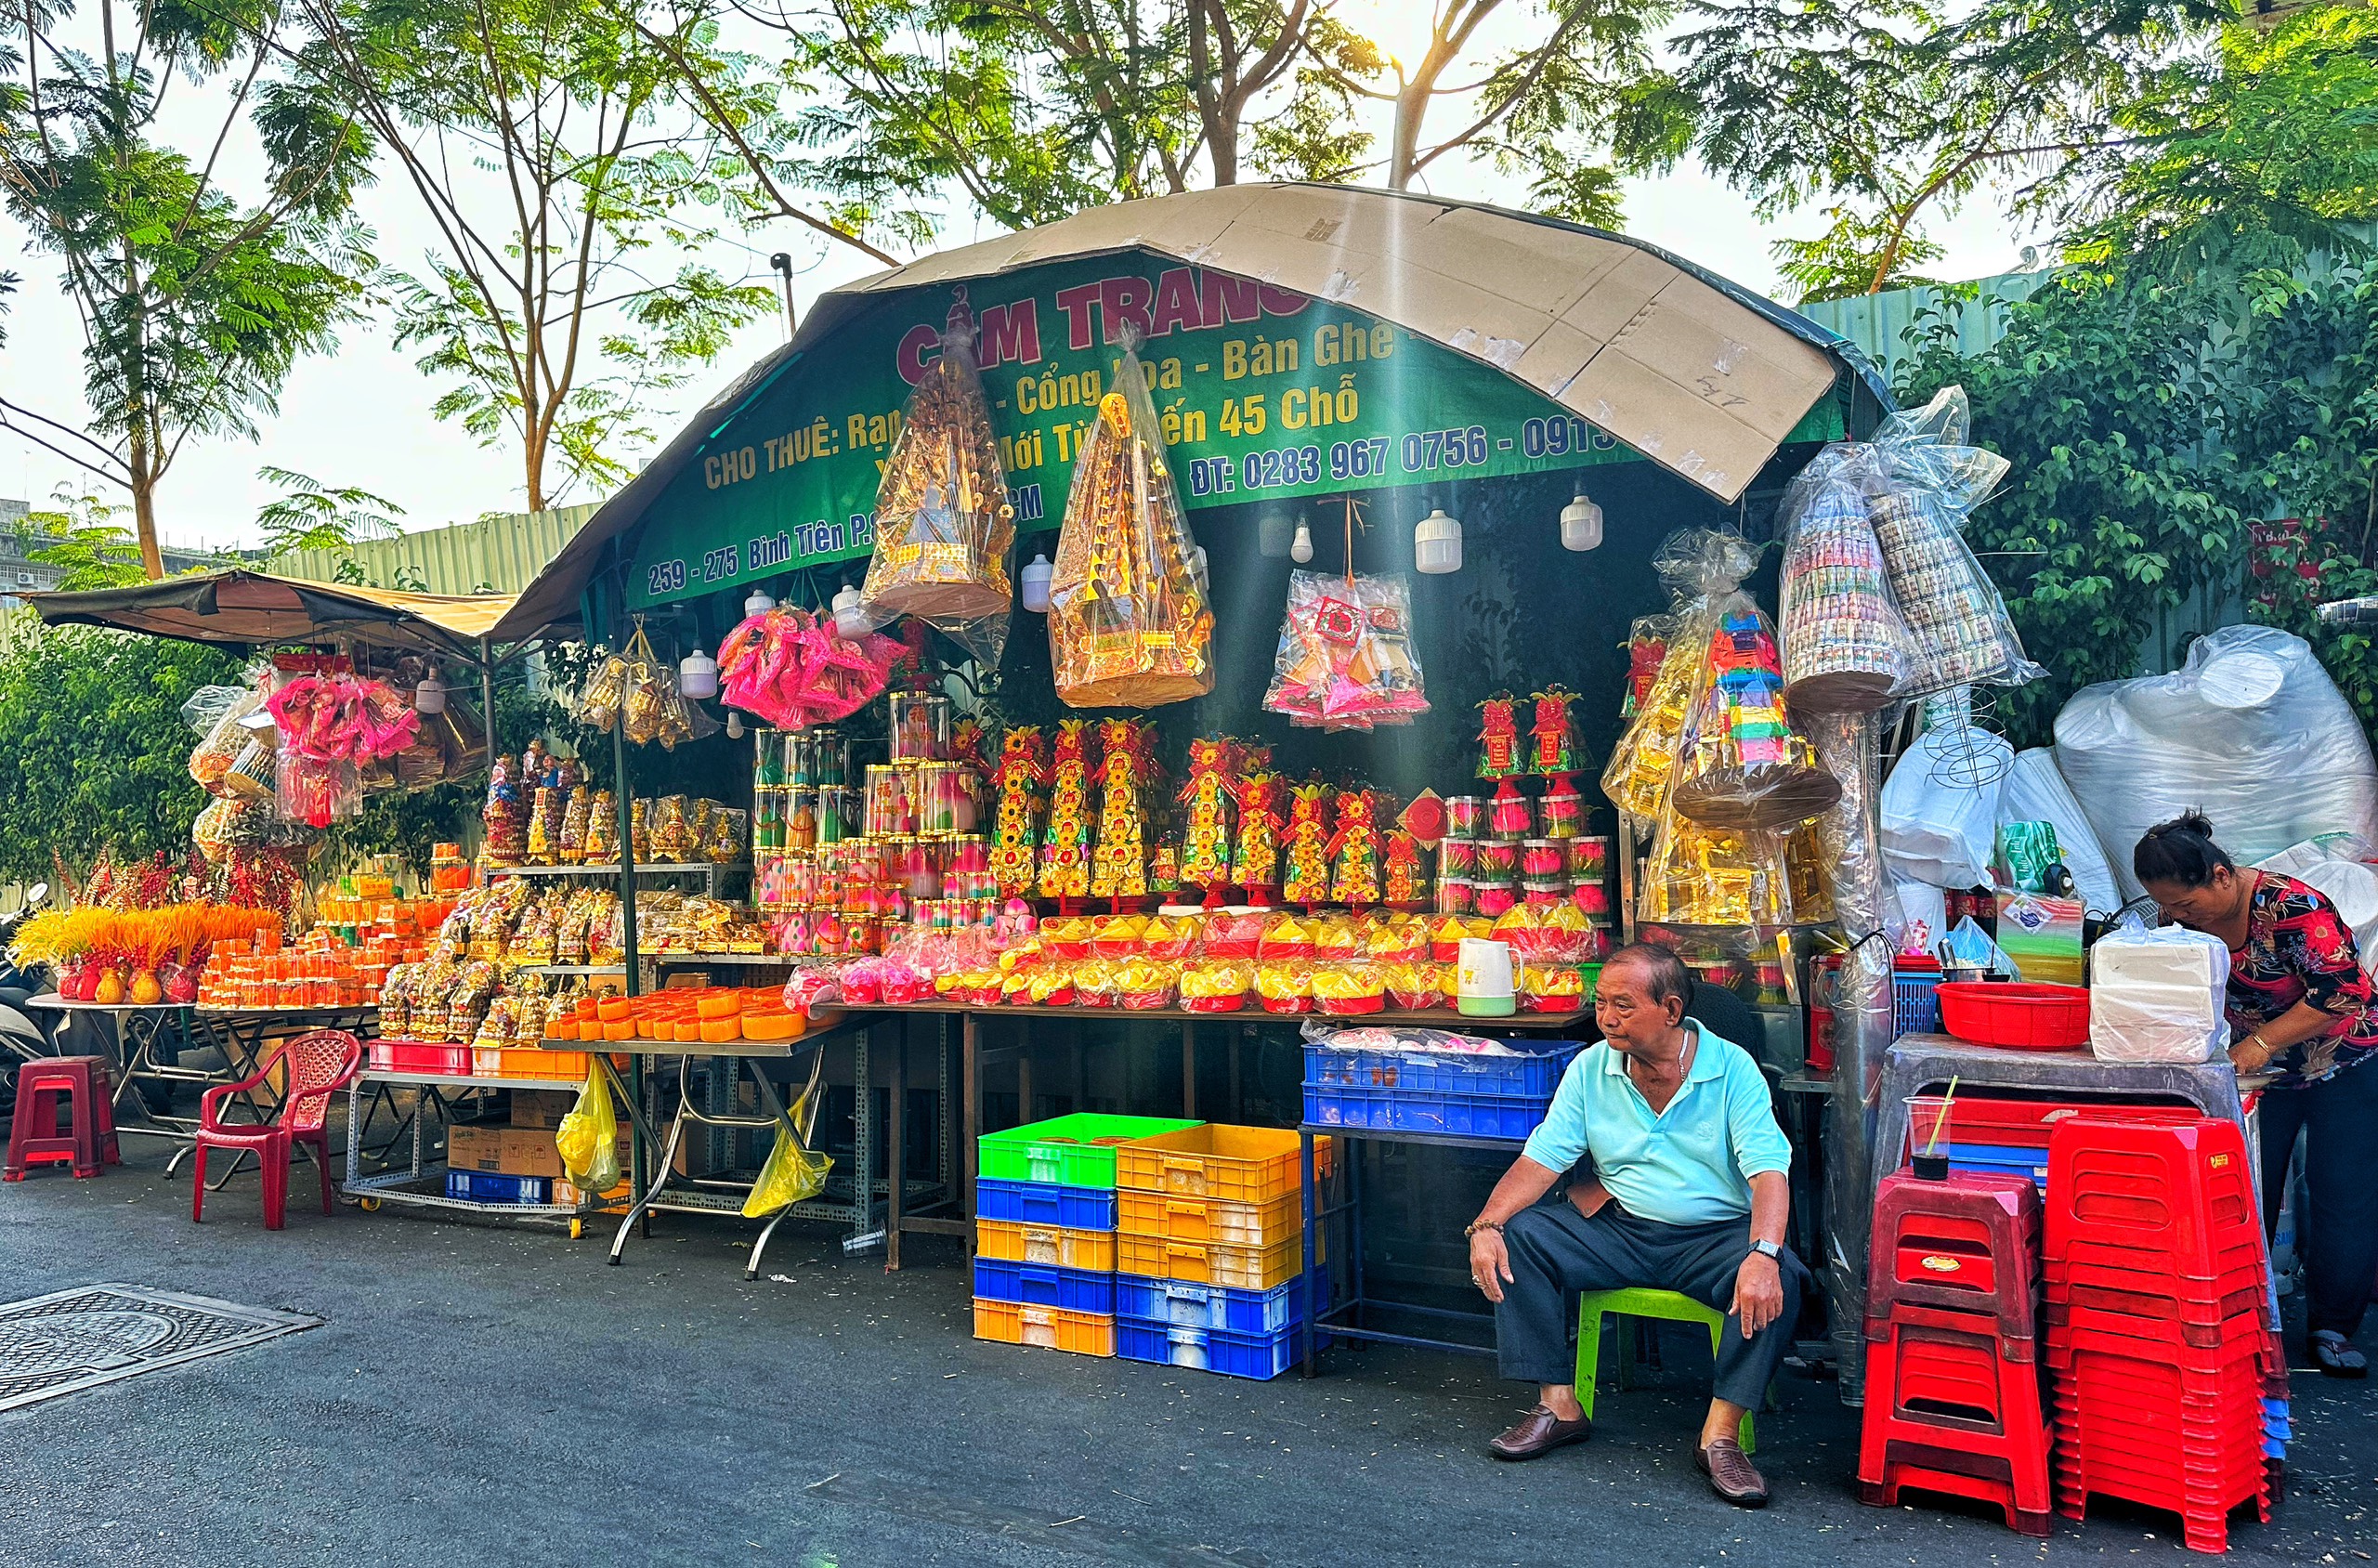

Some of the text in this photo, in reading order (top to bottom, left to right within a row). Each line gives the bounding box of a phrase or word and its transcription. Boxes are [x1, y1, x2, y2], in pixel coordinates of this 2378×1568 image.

[704, 446, 756, 490] CHO
[764, 415, 840, 474] THUÊ:
[1016, 361, 1103, 415] Cổng
[1113, 357, 1182, 391] oa
[1222, 334, 1299, 381] Bàn
[1160, 397, 1207, 446] ến
[1219, 394, 1267, 438] 45
[1281, 372, 1359, 430] Chỗ
[648, 559, 686, 595] 259
[704, 544, 739, 584] 275
[748, 529, 791, 571] Bình
[794, 519, 845, 556] Tiên
[1190, 456, 1235, 497] ĐT:
[1243, 445, 1322, 490] 0283
[1329, 436, 1392, 480] 967
[1401, 425, 1488, 473] 0756
